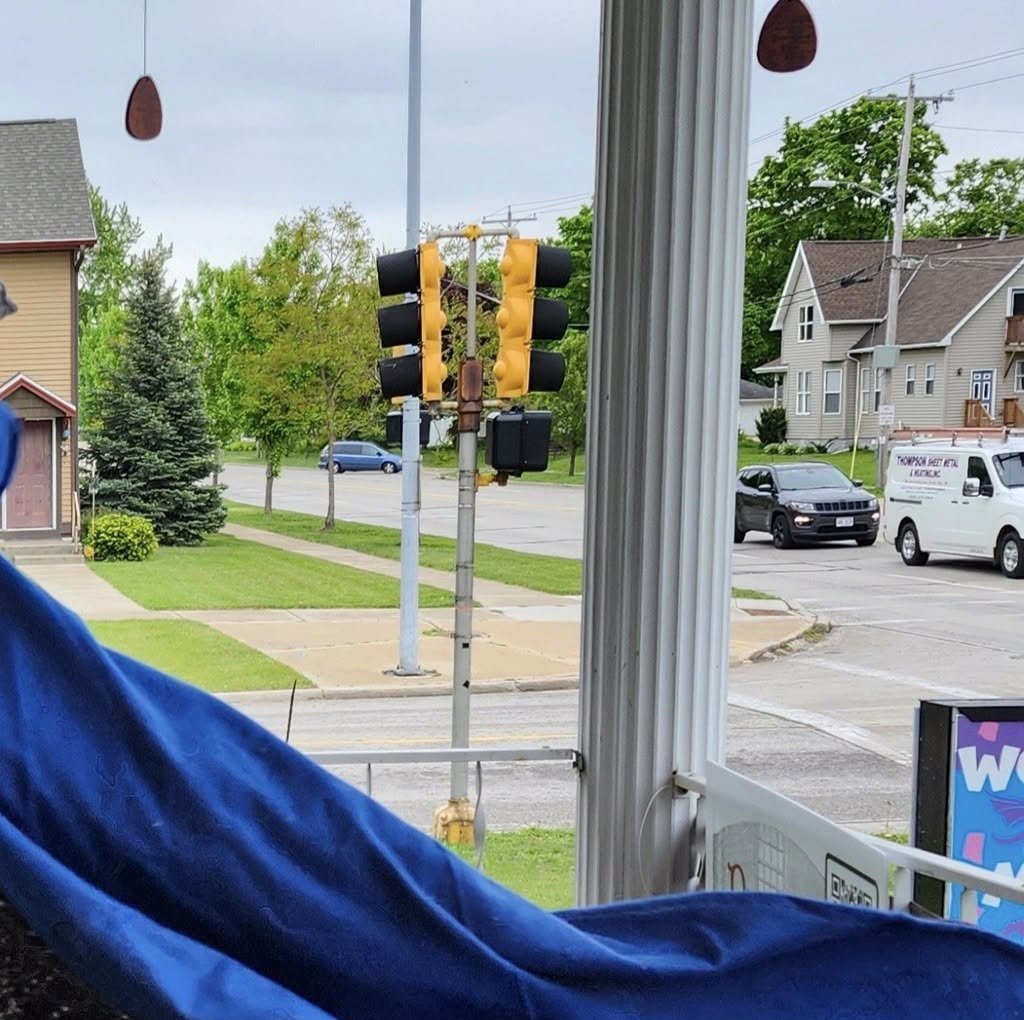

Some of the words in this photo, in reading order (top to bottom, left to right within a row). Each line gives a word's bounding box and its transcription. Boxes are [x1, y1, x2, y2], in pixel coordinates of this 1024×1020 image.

[897, 455, 927, 467] THOMPSON
[927, 457, 943, 467] SHEET
[943, 458, 959, 468] METAL
[958, 745, 1024, 792] W
